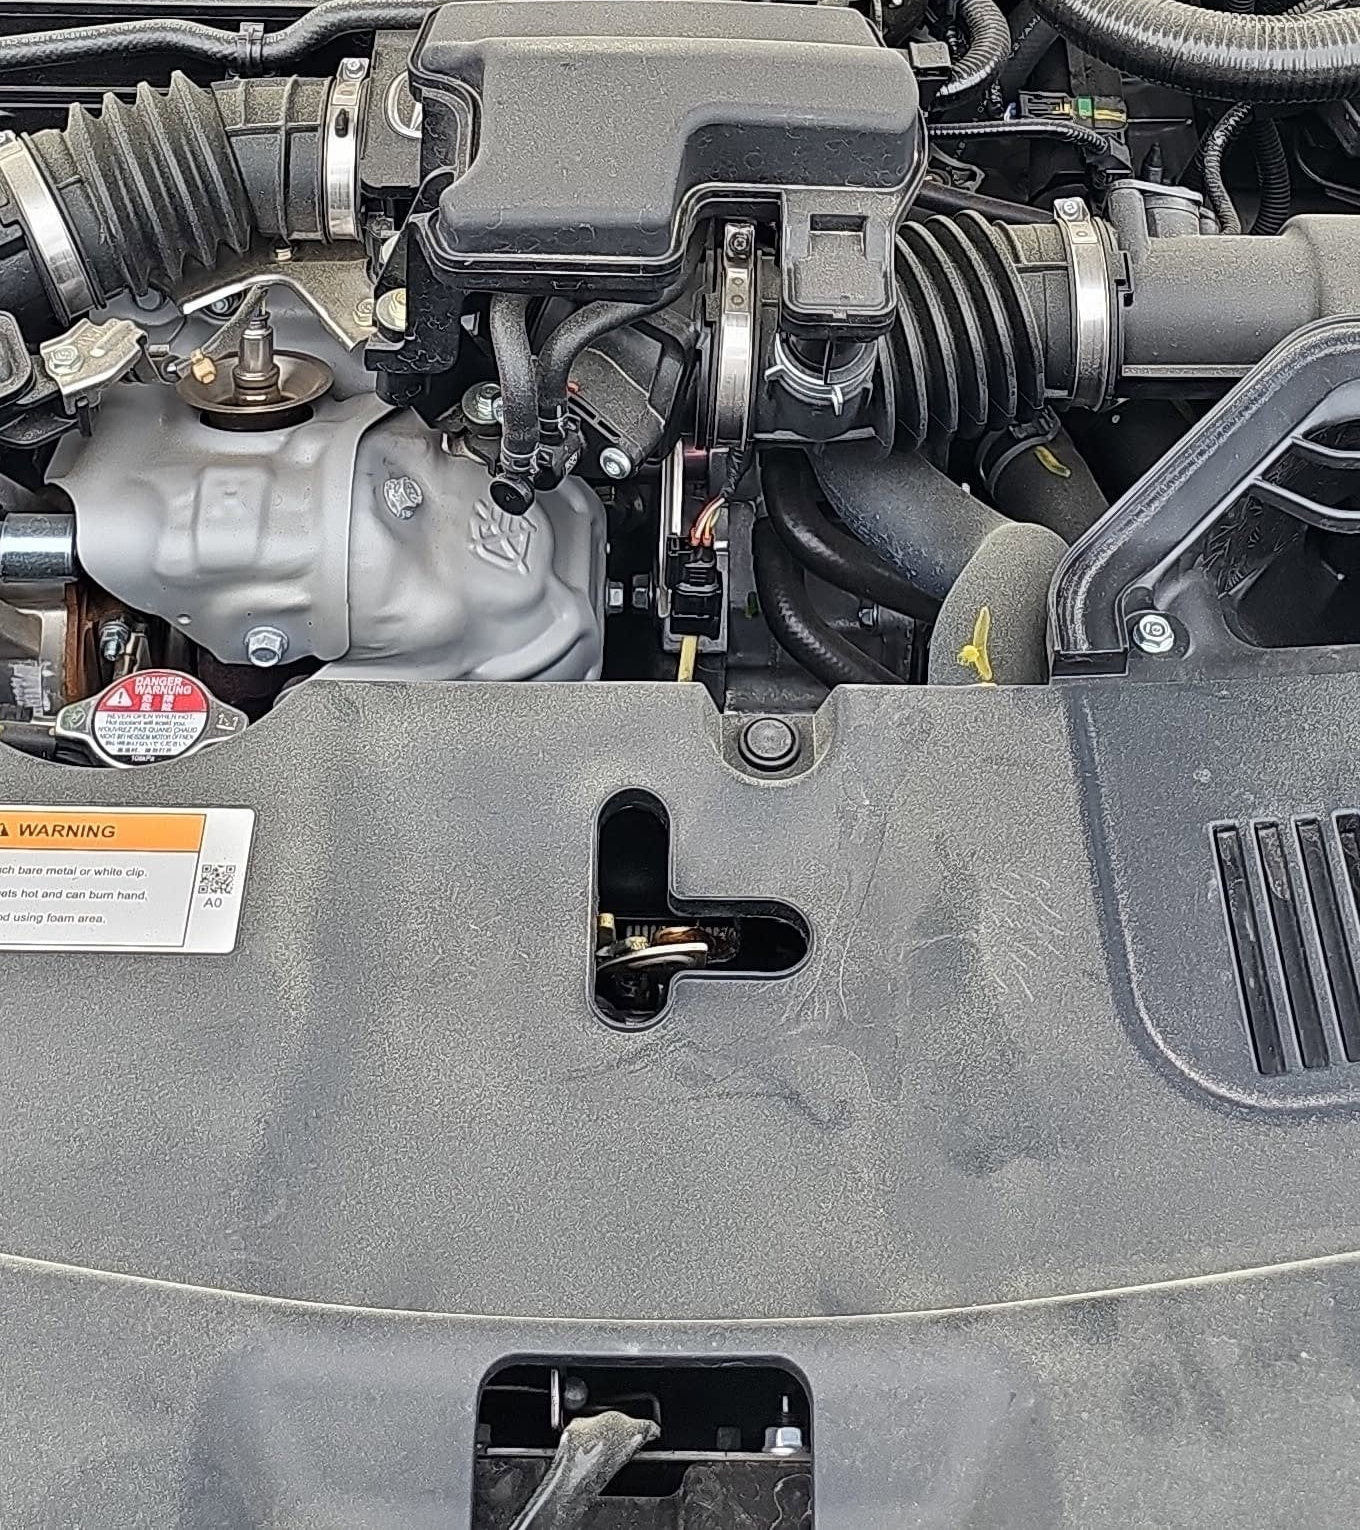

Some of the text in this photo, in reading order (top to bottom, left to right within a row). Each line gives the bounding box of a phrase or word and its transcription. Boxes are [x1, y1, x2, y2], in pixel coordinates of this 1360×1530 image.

[136, 677, 183, 686] DANGER
[135, 685, 192, 695] WARNUNG
[19, 823, 116, 840] WARNING
[18, 866, 43, 875] bare
[46, 866, 77, 875] metal
[80, 868, 92, 876] or
[94, 867, 123, 876] white
[126, 868, 147, 878] clip.
[21, 889, 39, 898] hot
[42, 890, 63, 898] and
[65, 891, 85, 899] can
[117, 890, 148, 901] hand.
[13, 913, 43, 924] using
[46, 913, 75, 923] foam
[78, 915, 106, 924] area.
